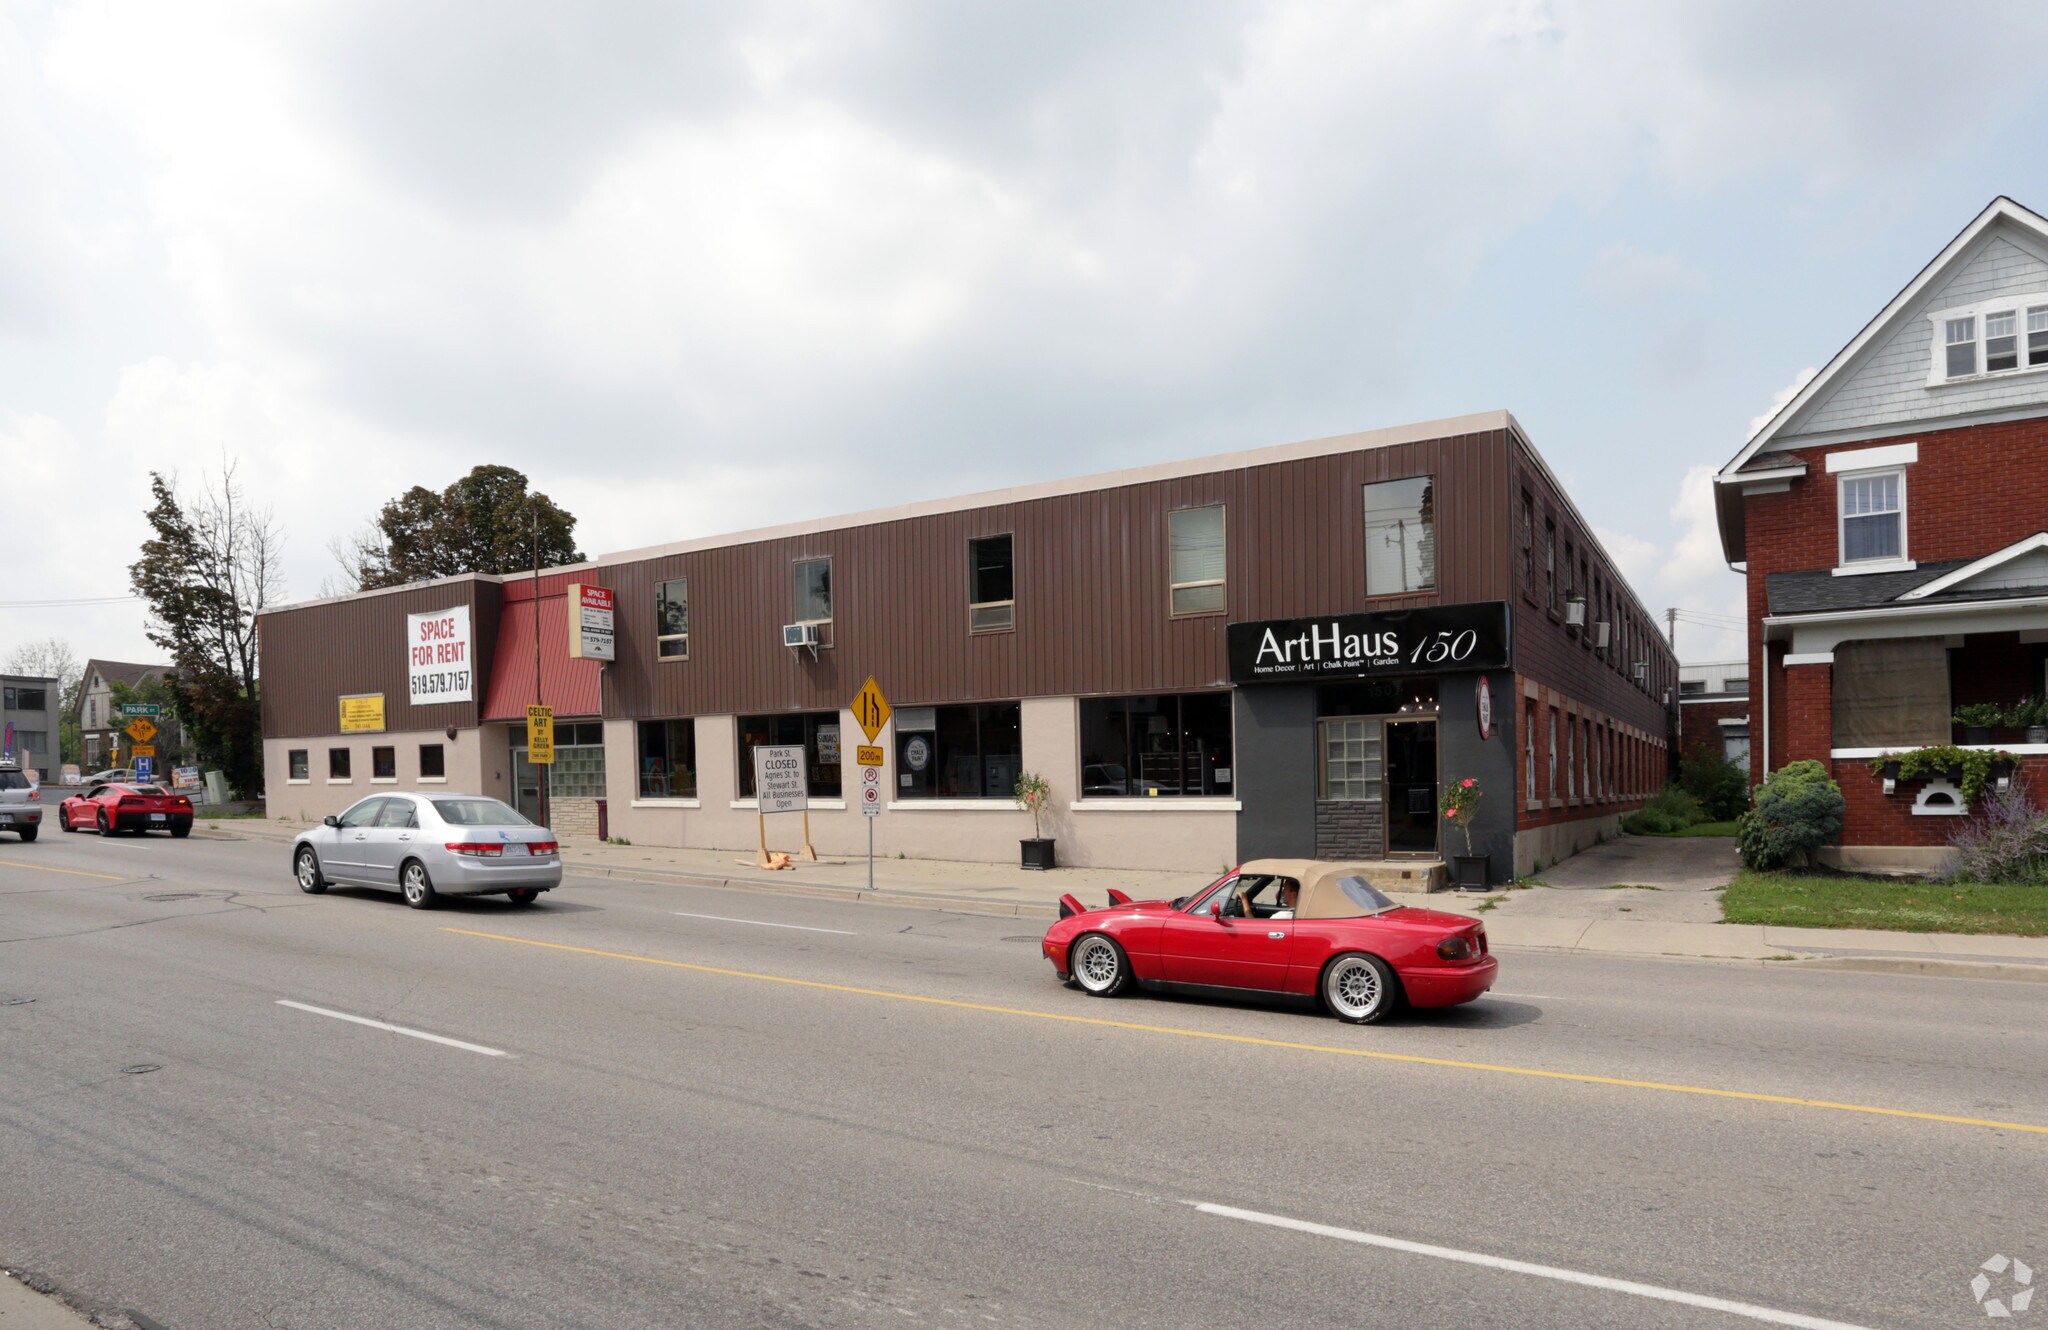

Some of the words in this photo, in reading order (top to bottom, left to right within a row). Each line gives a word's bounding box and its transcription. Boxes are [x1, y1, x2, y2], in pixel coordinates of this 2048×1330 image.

[587, 589, 606, 599] SPACE
[582, 597, 612, 608] AVAILABLE
[421, 618, 455, 641] SPACE
[590, 636, 612, 644] 579-7157
[1255, 622, 1399, 664] ArtHaus
[1410, 629, 1477, 664] 150
[412, 645, 433, 666] FOR
[437, 641, 465, 664] RENT
[1254, 666, 1273, 674] Home
[1275, 664, 1295, 672] Decor
[1323, 660, 1342, 669] Chalk
[1373, 657, 1399, 666] Garden
[412, 671, 469, 695] 519.579.7157
[126, 706, 149, 714] PARK
[528, 706, 552, 717] CELTIC
[534, 718, 547, 727] ART
[138, 758, 149, 771] H
[765, 759, 797, 770] CLOSED
[765, 771, 783, 781] Agnes
[793, 770, 799, 778] to
[767, 781, 790, 789] Stewart
[763, 791, 771, 799] All
[773, 790, 804, 799] Businesses
[776, 800, 792, 809] Open
